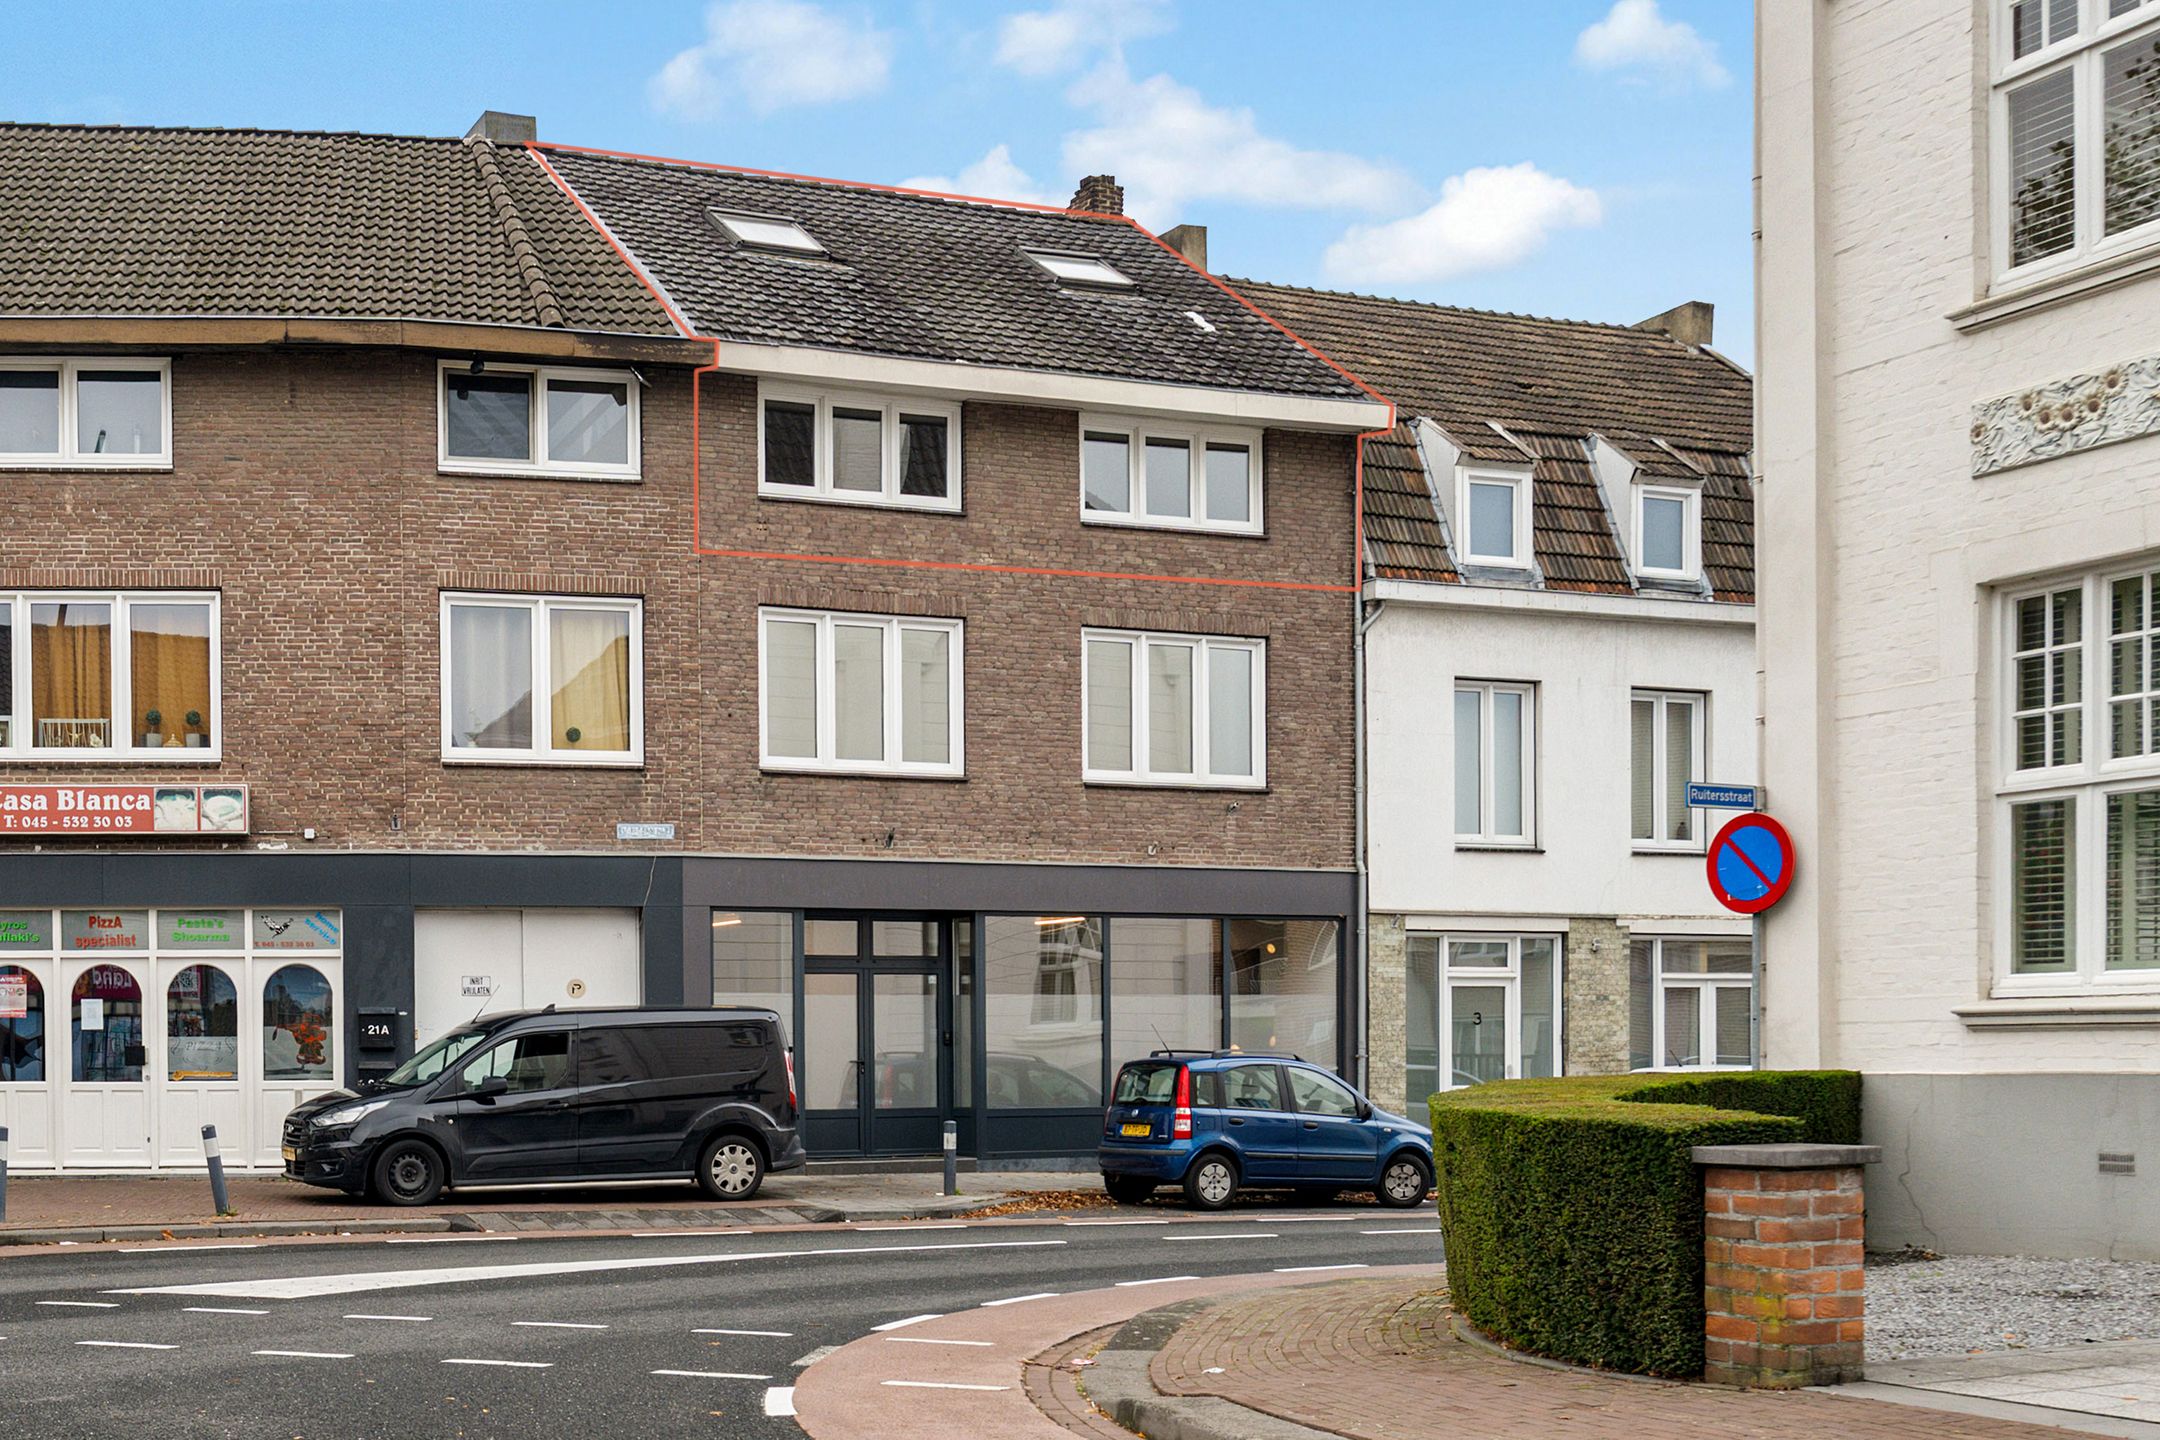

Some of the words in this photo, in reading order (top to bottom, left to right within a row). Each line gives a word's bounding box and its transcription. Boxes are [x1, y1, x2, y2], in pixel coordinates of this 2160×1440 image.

[0, 789, 48, 811] asa
[56, 789, 151, 811] Blanca
[1690, 788, 1753, 803] Ruitersstraat
[3, 814, 17, 828] T:
[21, 815, 48, 828] 045
[62, 815, 89, 828] 532
[93, 815, 111, 828] 30
[114, 815, 133, 828] 03
[75, 934, 136, 949] specialist
[1472, 1011, 1482, 1025] 3
[367, 1025, 389, 1035] 21A
